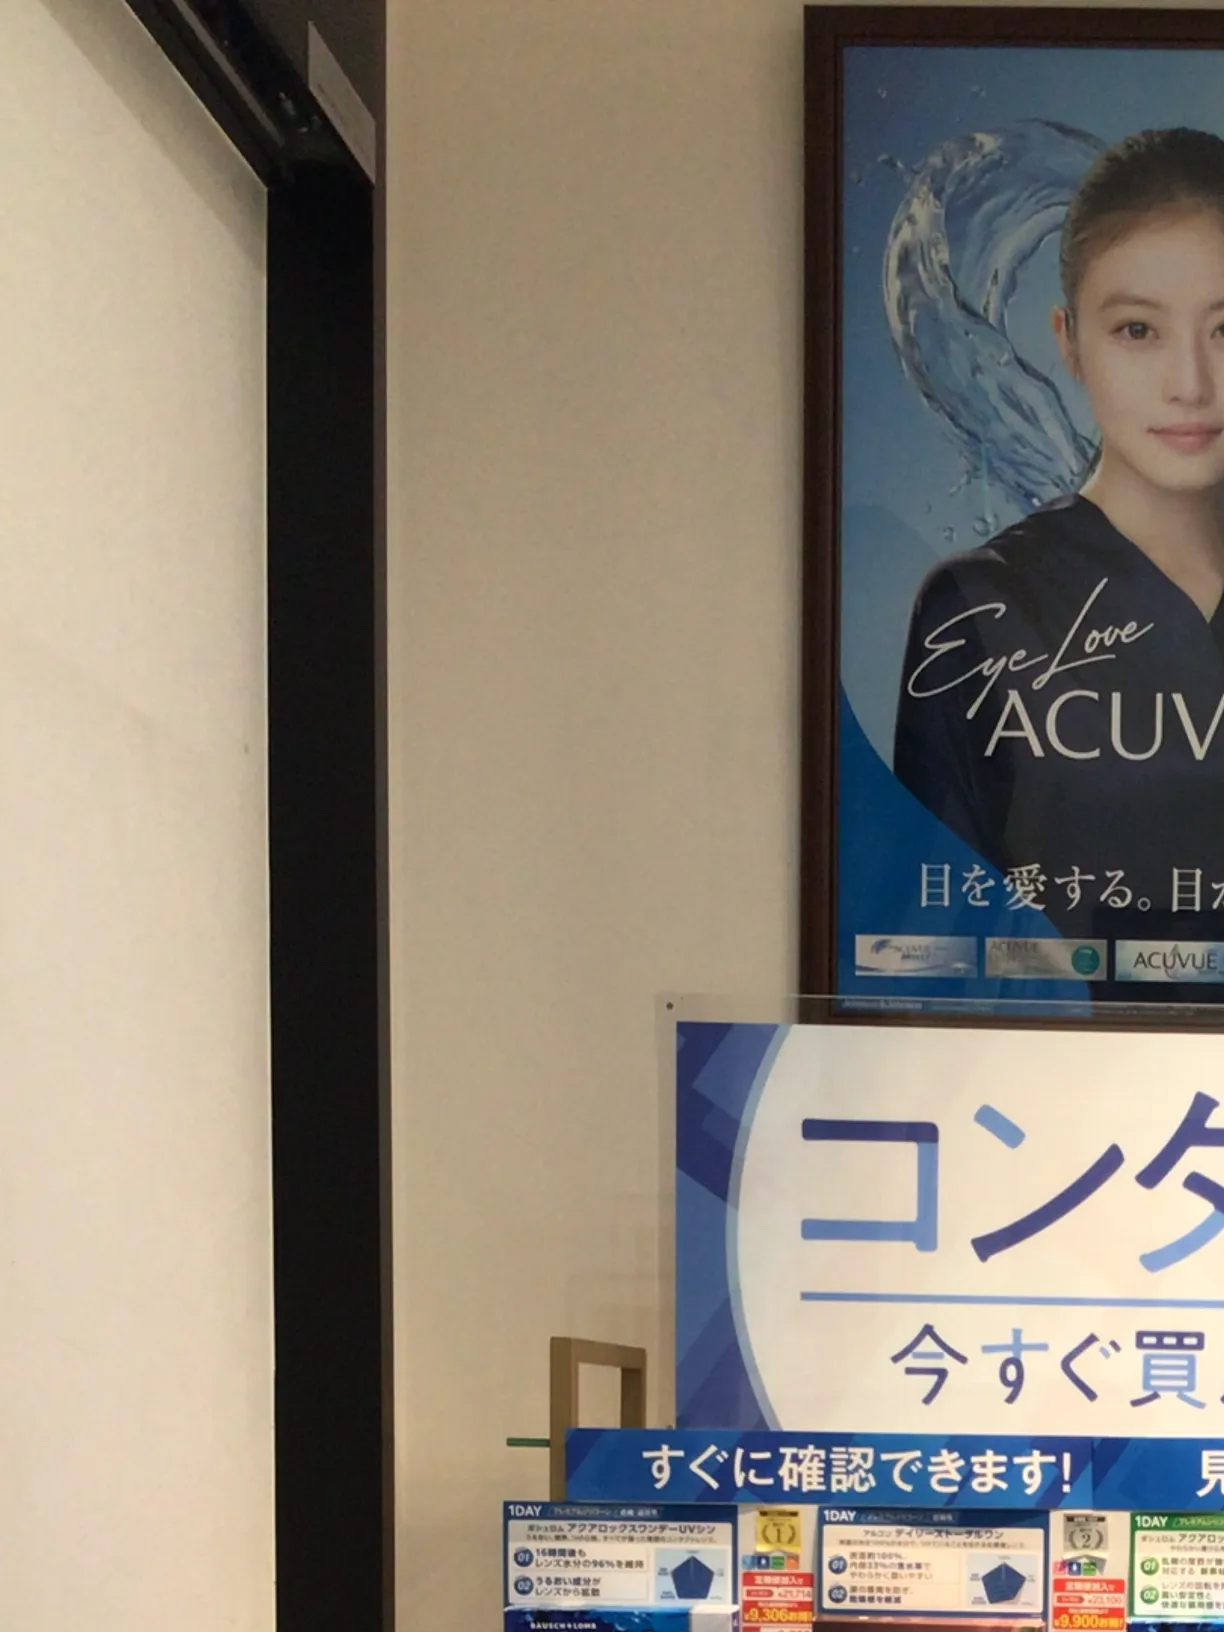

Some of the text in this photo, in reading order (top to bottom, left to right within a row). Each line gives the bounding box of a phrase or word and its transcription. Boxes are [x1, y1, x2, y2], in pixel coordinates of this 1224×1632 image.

[907, 578, 1155, 720] Eye Love
[1133, 951, 1218, 973] ACUVUE
[643, 1443, 1071, 1494] すぐに確認できます!
[508, 1506, 541, 1516] 1DAY
[824, 1511, 856, 1521] 1DAY
[1135, 1516, 1168, 1527] 1DAY
